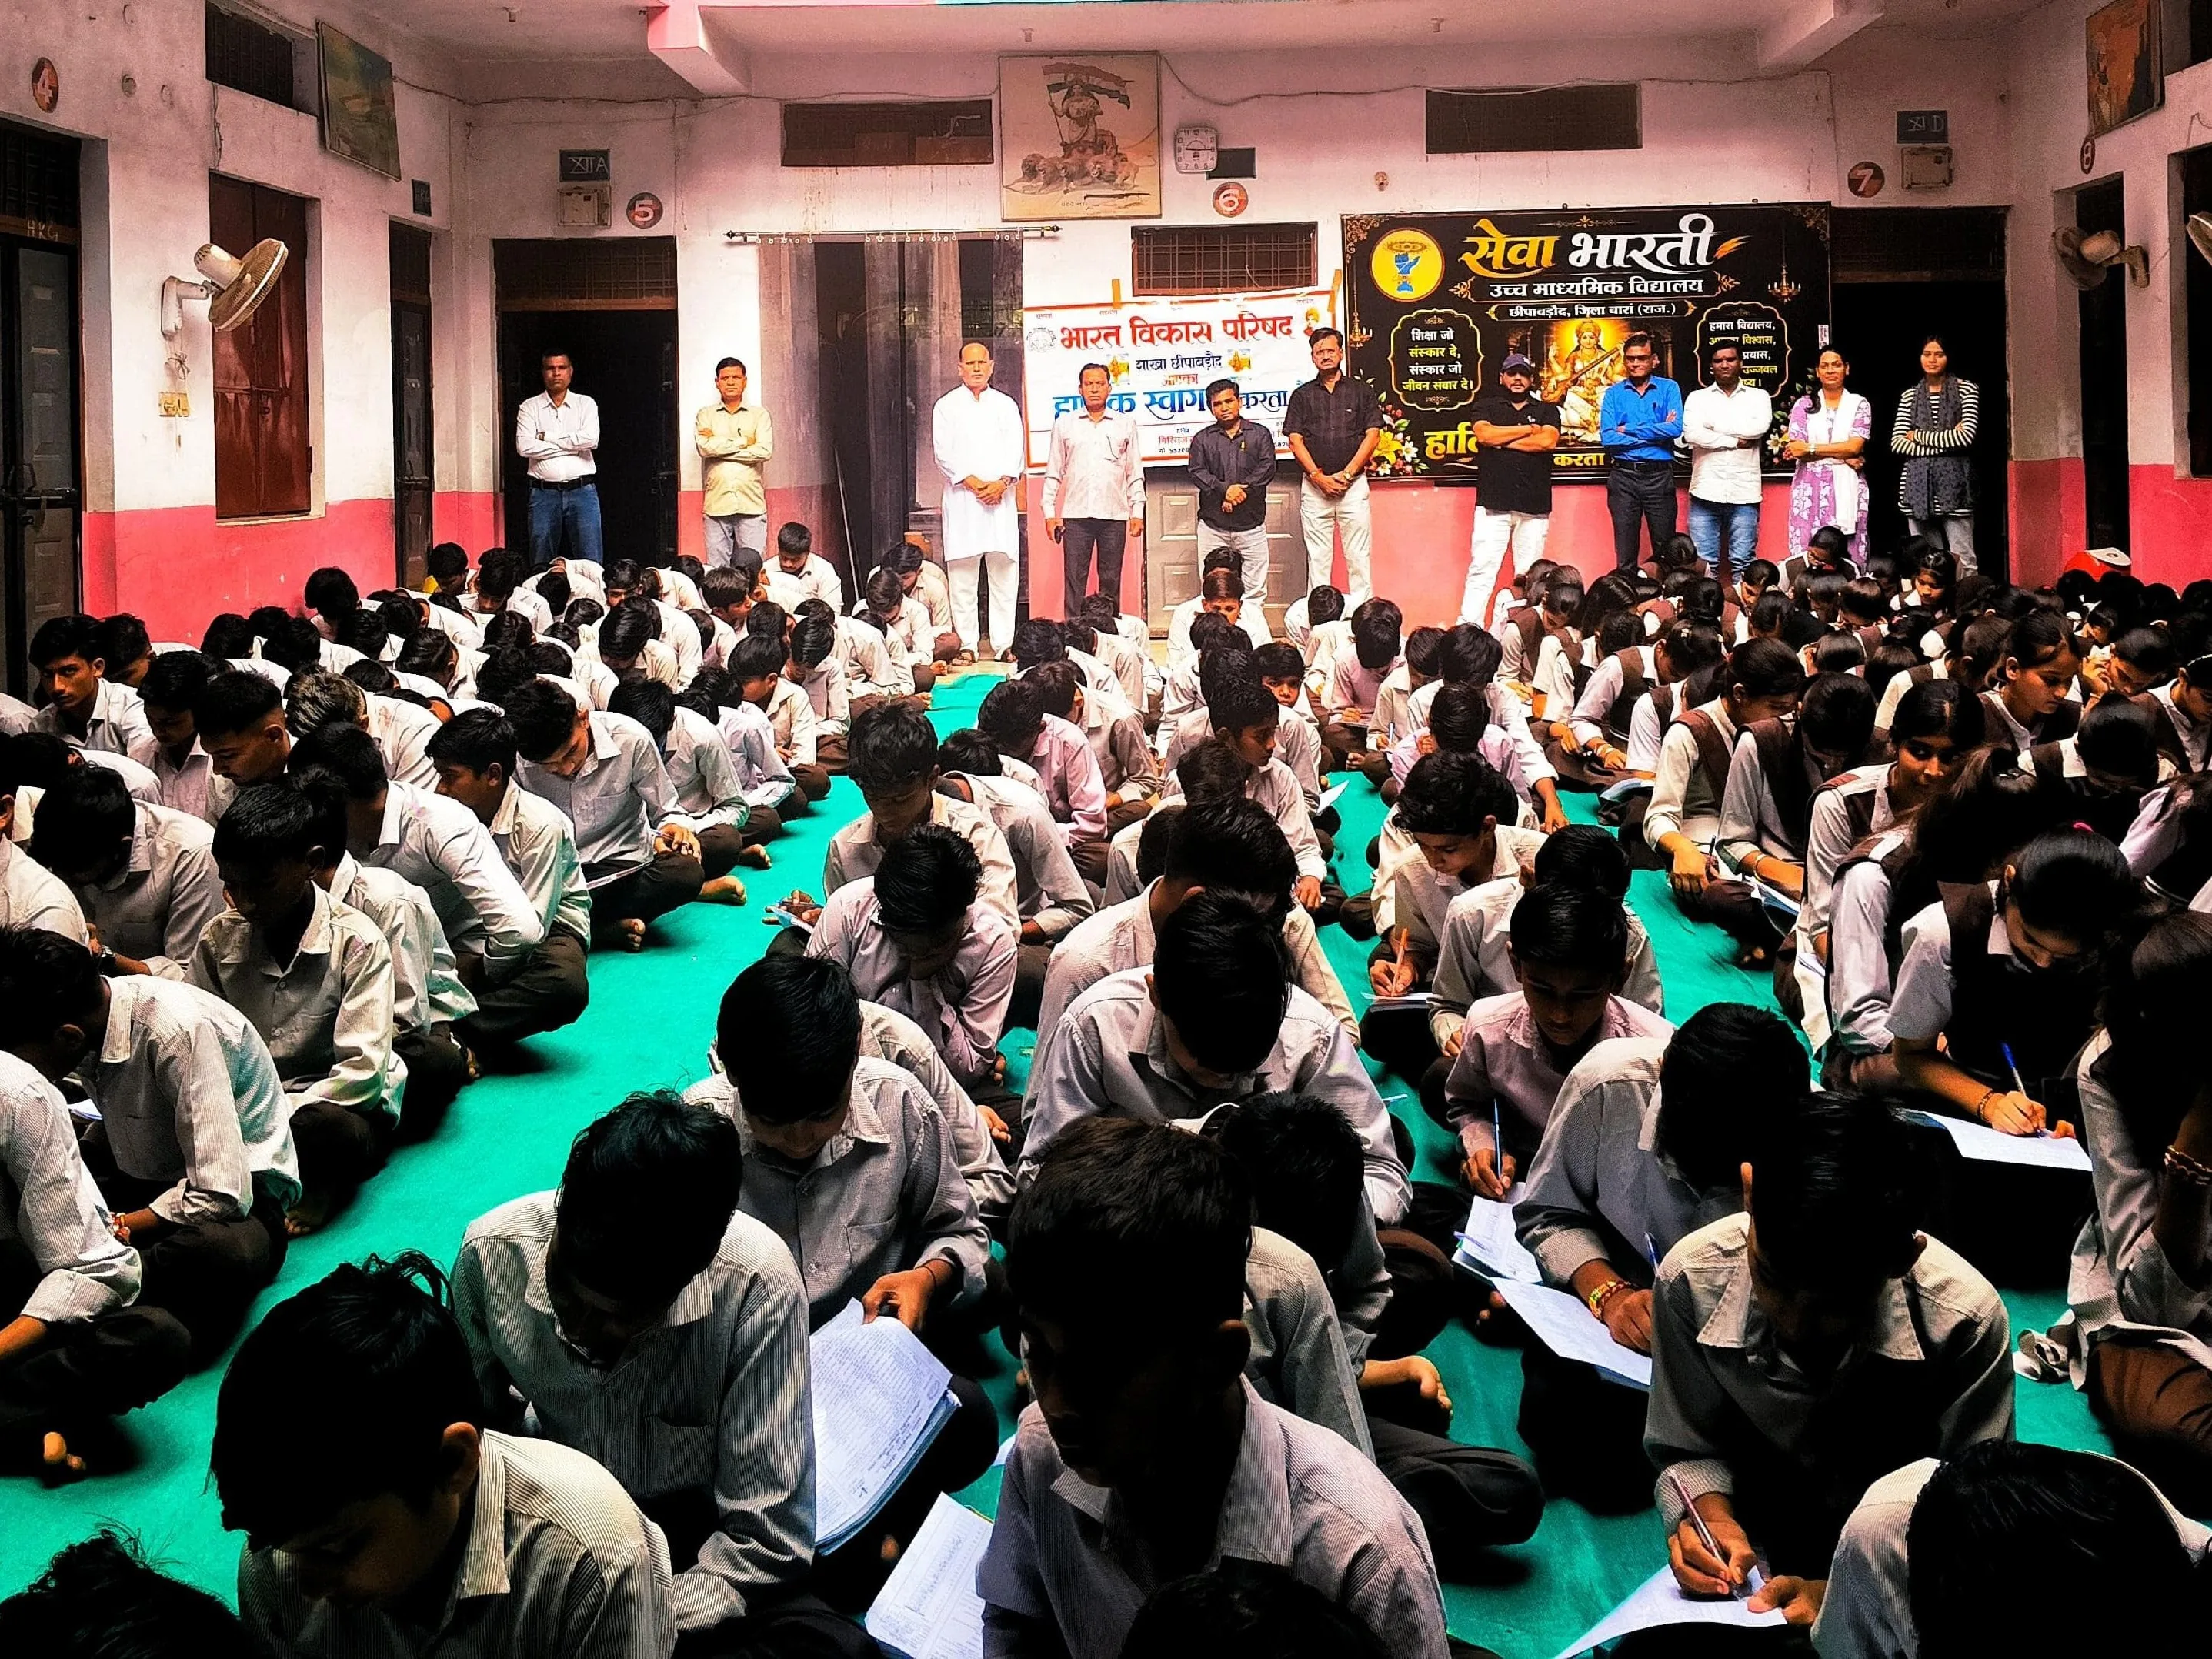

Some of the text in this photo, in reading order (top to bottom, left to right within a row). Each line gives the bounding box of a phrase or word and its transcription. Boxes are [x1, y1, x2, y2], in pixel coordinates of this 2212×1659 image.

[37, 67, 53, 103] 4
[1855, 169, 1874, 192] 7
[1218, 189, 1239, 212] 6
[633, 199, 655, 222] 5
[1458, 213, 1719, 279] सेवा भारती
[1489, 276, 1704, 298] उच्च माध्यमिक विद्यालय
[1574, 304, 1606, 316] जिला
[1637, 302, 1677, 315] (राज.)
[1060, 310, 1293, 349] भारत विकास परिषद
[1708, 319, 1776, 332] हमारा विद्यालय,
[1410, 327, 1455, 342] शिक्षा जो
[1742, 333, 1777, 345] विश्वास,
[1408, 343, 1461, 359] संस्कार दे,
[1741, 350, 1771, 360] प्रयास,
[1136, 358, 1166, 371] शाखा
[1408, 361, 1463, 376] संस्कार जो
[1402, 378, 1430, 391] जीवन
[1432, 378, 1458, 391] संवार
[1142, 389, 1206, 421] स्वाग
[1239, 390, 1289, 413] करता
